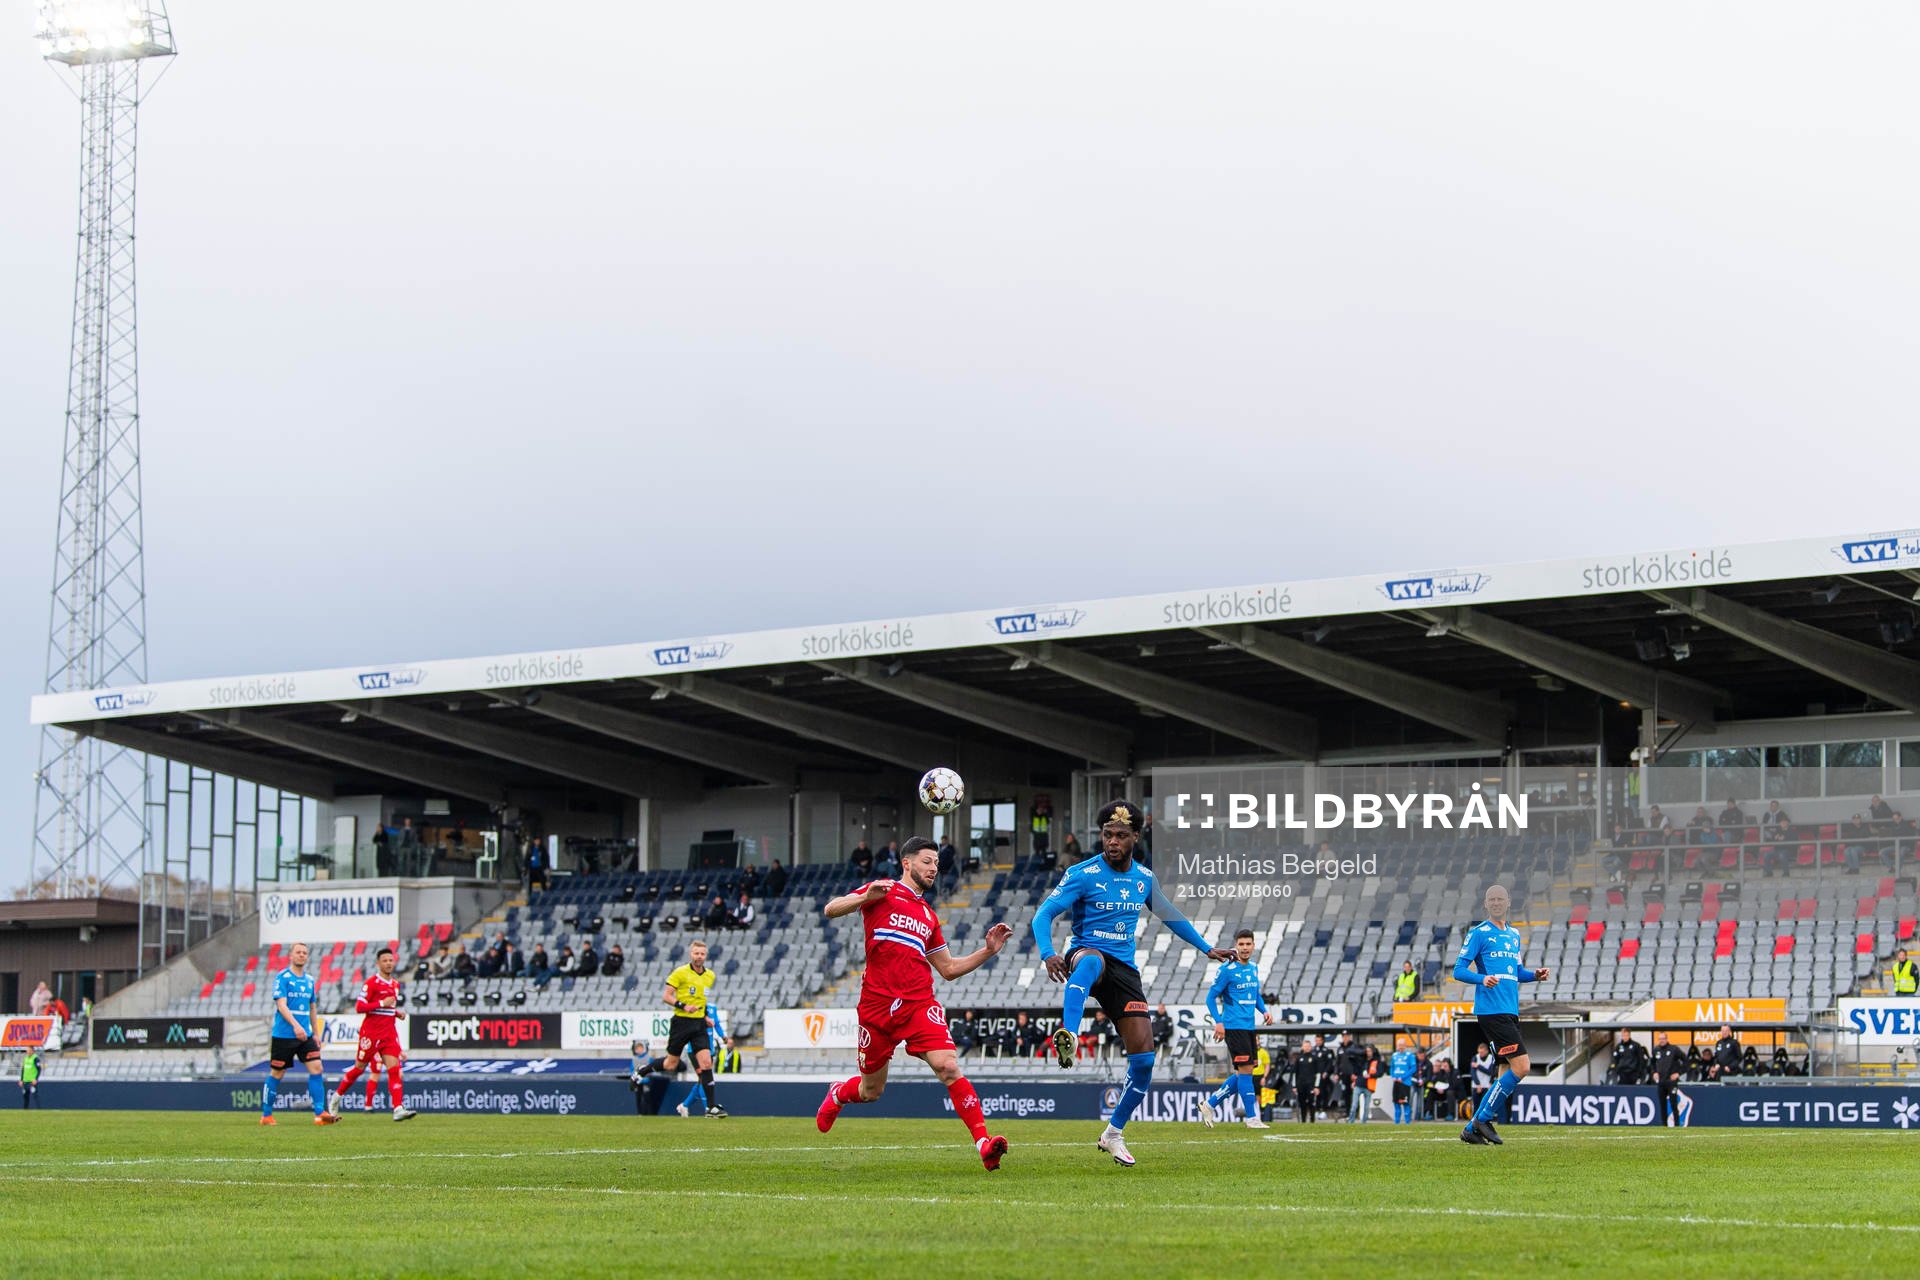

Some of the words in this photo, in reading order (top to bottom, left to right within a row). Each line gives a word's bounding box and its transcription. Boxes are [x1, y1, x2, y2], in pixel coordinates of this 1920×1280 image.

[1850, 542, 1896, 562] KYL
[1583, 550, 1732, 589] storköksidé
[1391, 581, 1431, 599] KYL
[1437, 576, 1470, 593] teknik
[1163, 587, 1292, 623] storköksidé
[1000, 616, 1035, 633] KYL
[802, 622, 914, 656] storköksidé
[658, 648, 689, 665] KYL
[486, 654, 584, 683] storköksidé
[209, 677, 296, 704] storköksidé
[361, 674, 389, 689] KYL
[287, 896, 394, 918] MOTORHALLAND
[1095, 901, 1144, 911] GETING
[889, 913, 932, 940] SERNEK
[1694, 1003, 1744, 1022] MIN
[427, 1016, 542, 1047] sportringen
[231, 1090, 261, 1108] 1904
[402, 1090, 461, 1109] amhället
[464, 1089, 521, 1114] Getinge,
[524, 1089, 576, 1115] Sverige
[1739, 1102, 1880, 1122] GETINGE
